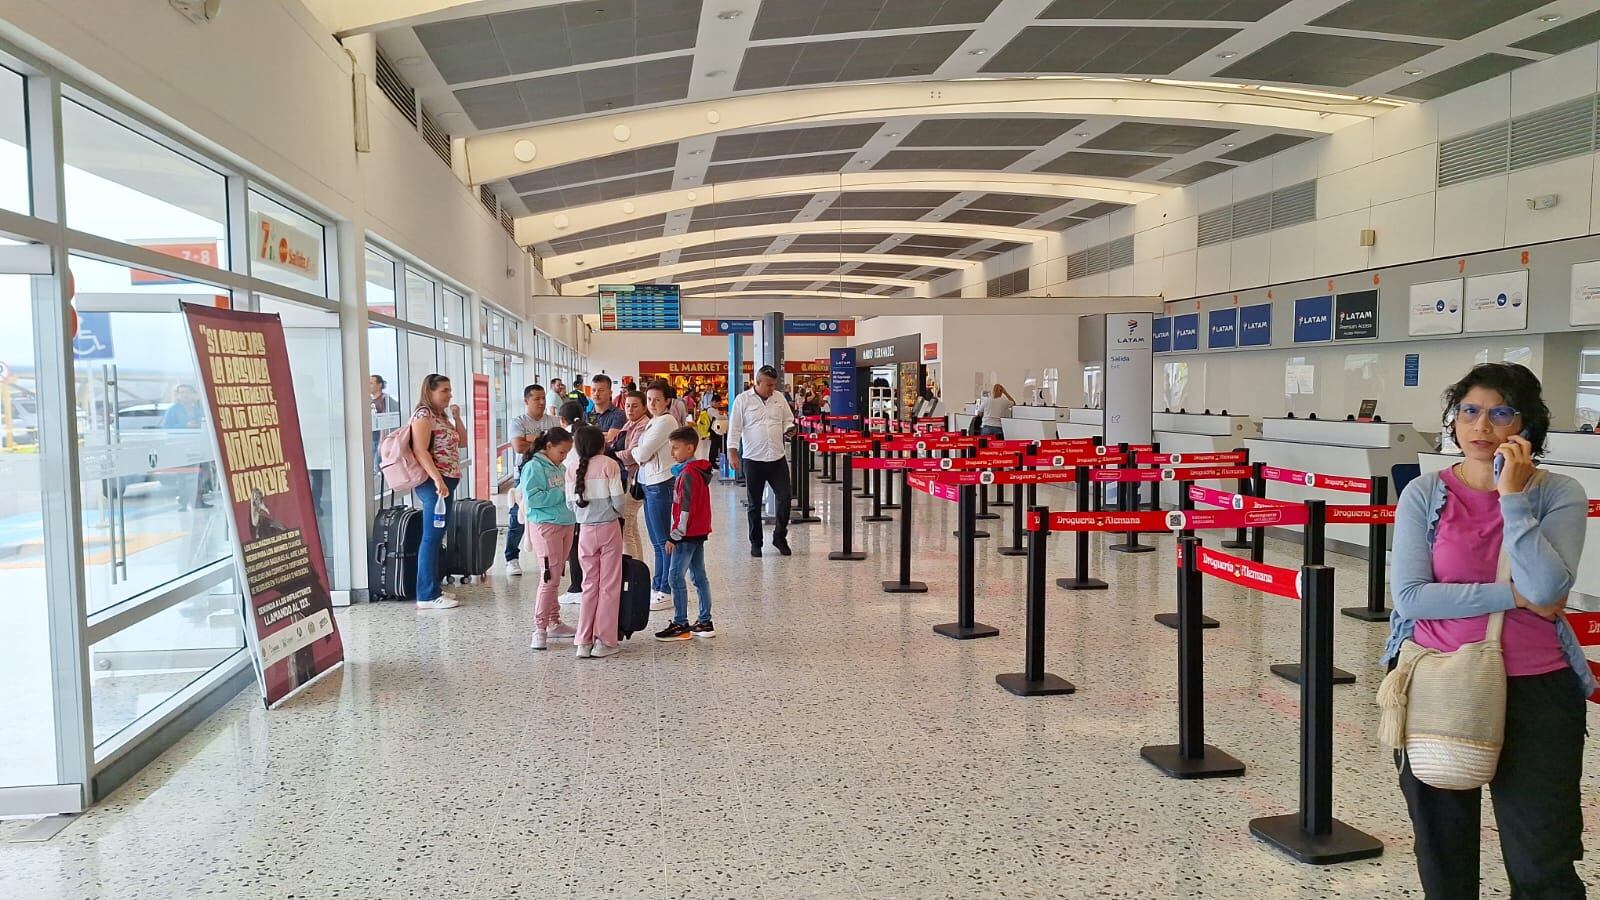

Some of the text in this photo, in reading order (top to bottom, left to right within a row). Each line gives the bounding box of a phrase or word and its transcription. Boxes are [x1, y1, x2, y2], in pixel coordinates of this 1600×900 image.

[1521, 251, 1529, 264] 8
[1458, 259, 1465, 273] 7
[1304, 315, 1327, 324] LATAM
[1346, 311, 1372, 320] LATAM
[1248, 321, 1267, 329] LATAM
[224, 357, 271, 384] BASURA
[669, 363, 679, 372] EL
[681, 363, 722, 372] MARKET
[1241, 565, 1273, 583] Alemana
[263, 604, 293, 626] LLAMANDO
[292, 602, 301, 613] AL
